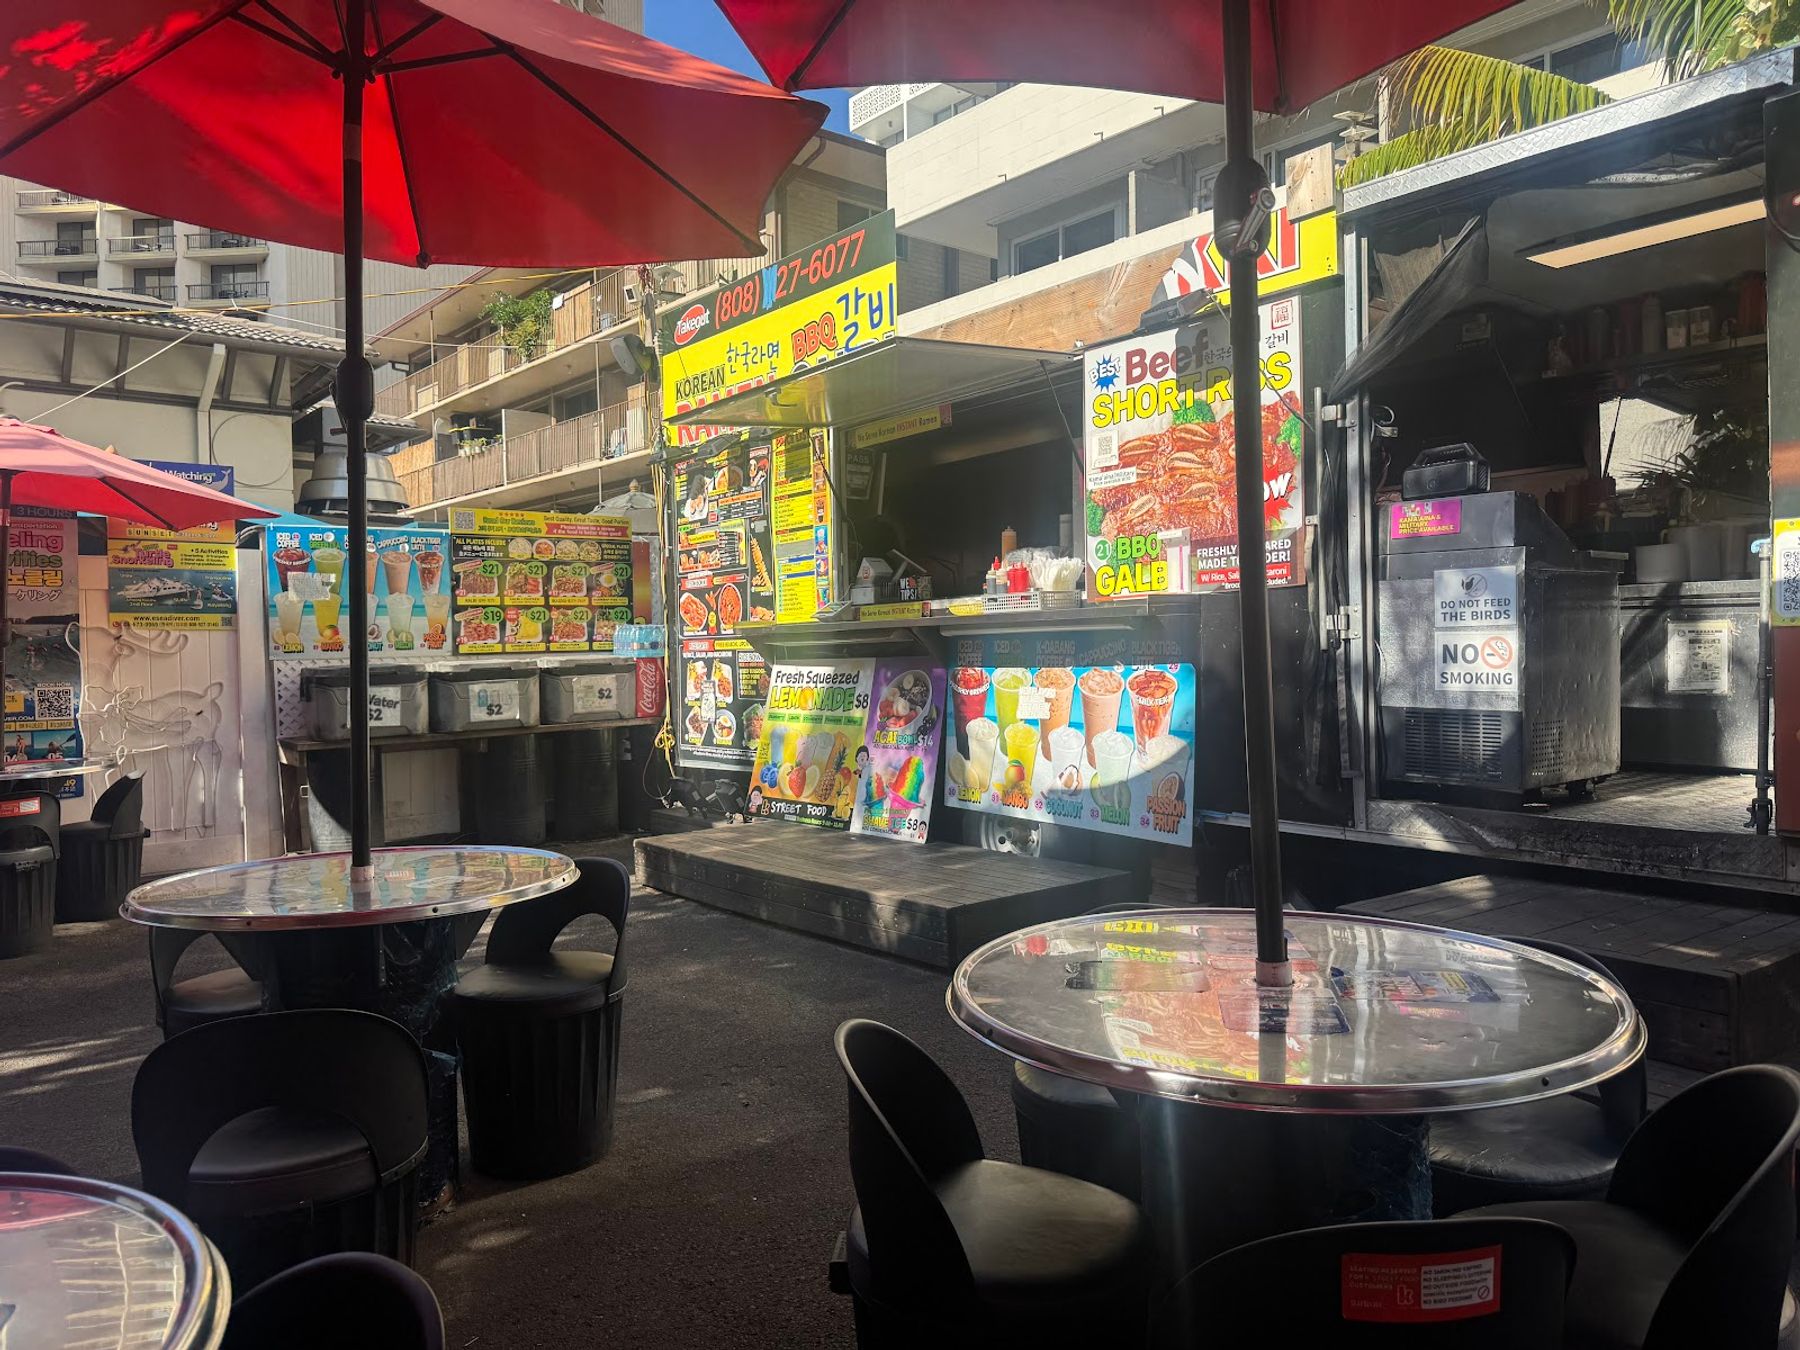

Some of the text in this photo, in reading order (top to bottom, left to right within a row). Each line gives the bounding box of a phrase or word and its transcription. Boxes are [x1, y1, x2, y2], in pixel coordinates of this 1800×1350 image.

[676, 229, 866, 335] Takeout (808) 27-6077
[791, 312, 838, 362] BBQ
[1264, 330, 1289, 349] 갈비
[1125, 328, 1209, 386] Beef
[1088, 357, 1121, 383] BEST
[675, 365, 726, 400] KOREAN
[1092, 351, 1293, 428] SHORT RS
[1097, 535, 1161, 559] 21 BBQ
[1197, 544, 1238, 558] FRESHLY
[482, 564, 499, 575] $21
[1199, 557, 1228, 570] MADE
[528, 565, 544, 576] $21
[571, 566, 587, 577] $21
[614, 566, 628, 577] $21
[1441, 598, 1511, 609] DO NOT FEED
[483, 611, 501, 622] $19
[530, 611, 546, 622] $21
[573, 610, 589, 621] $21
[614, 610, 628, 621] $21
[1441, 609, 1511, 622] THE BIRDS
[1442, 643, 1479, 664] NO
[775, 670, 804, 684] Fresh
[806, 670, 860, 688] Squeezed
[1440, 671, 1513, 686] SMOKING
[597, 688, 612, 699] $2
[854, 693, 869, 709] $8
[487, 704, 503, 716] $2
[917, 735, 934, 747] $14
[771, 802, 827, 816] STREET FOOD
[906, 818, 918, 831] $8
